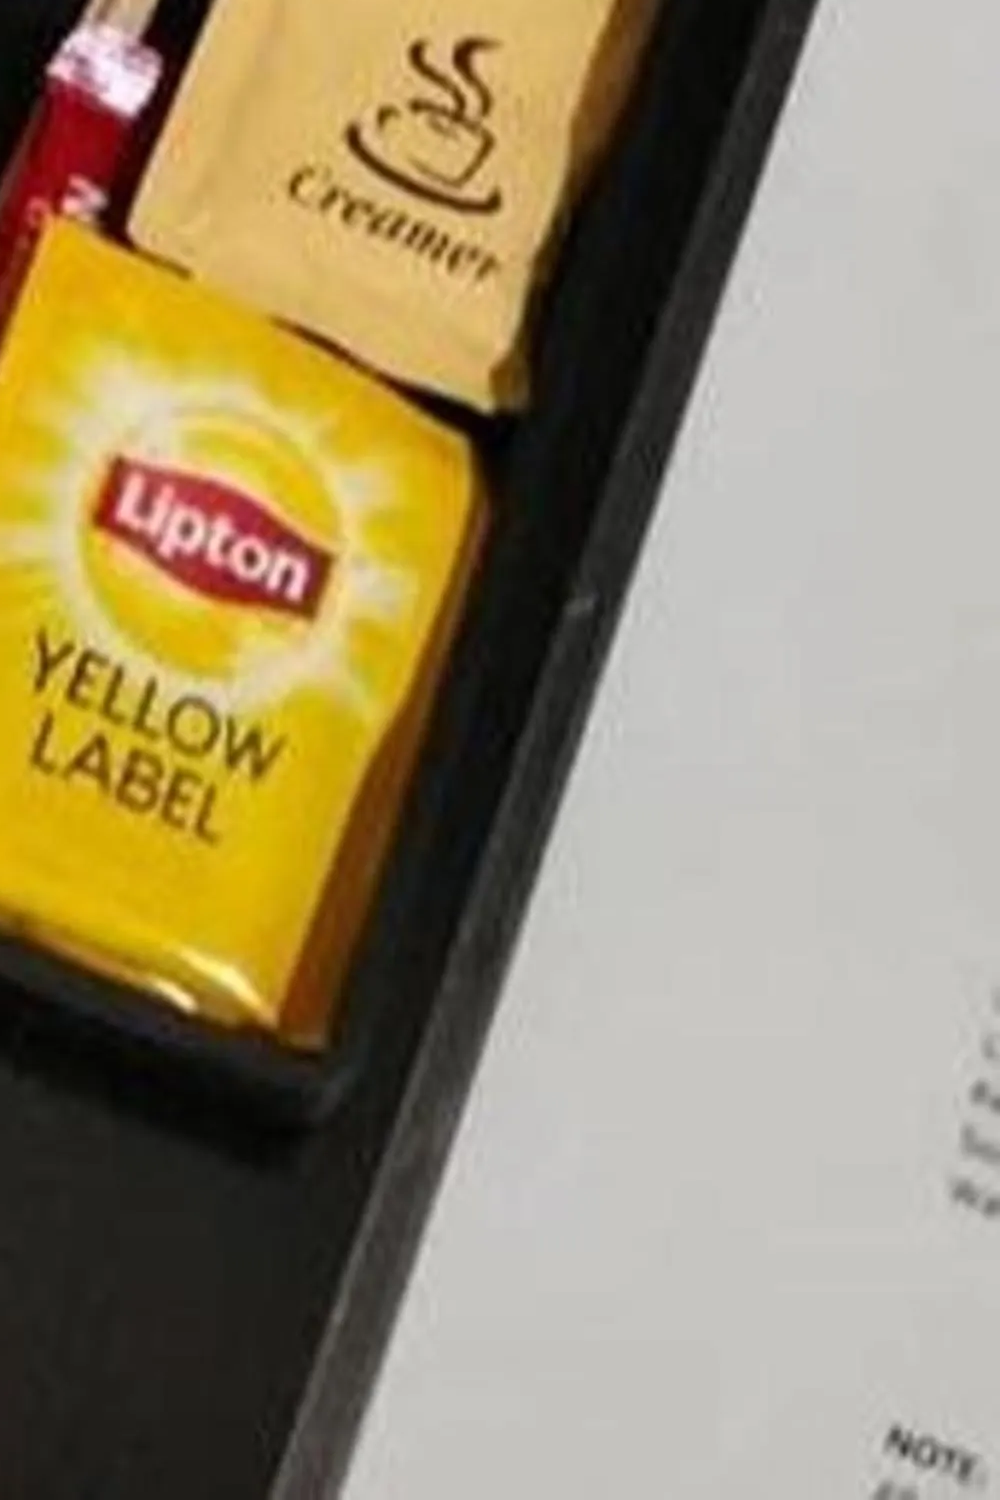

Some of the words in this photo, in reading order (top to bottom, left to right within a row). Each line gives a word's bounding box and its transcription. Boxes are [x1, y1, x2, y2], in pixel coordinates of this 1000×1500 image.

[289, 165, 499, 281] Creamer
[115, 472, 310, 600] Lipton
[32, 626, 286, 780] YELLOW
[30, 711, 220, 848] LABEL
